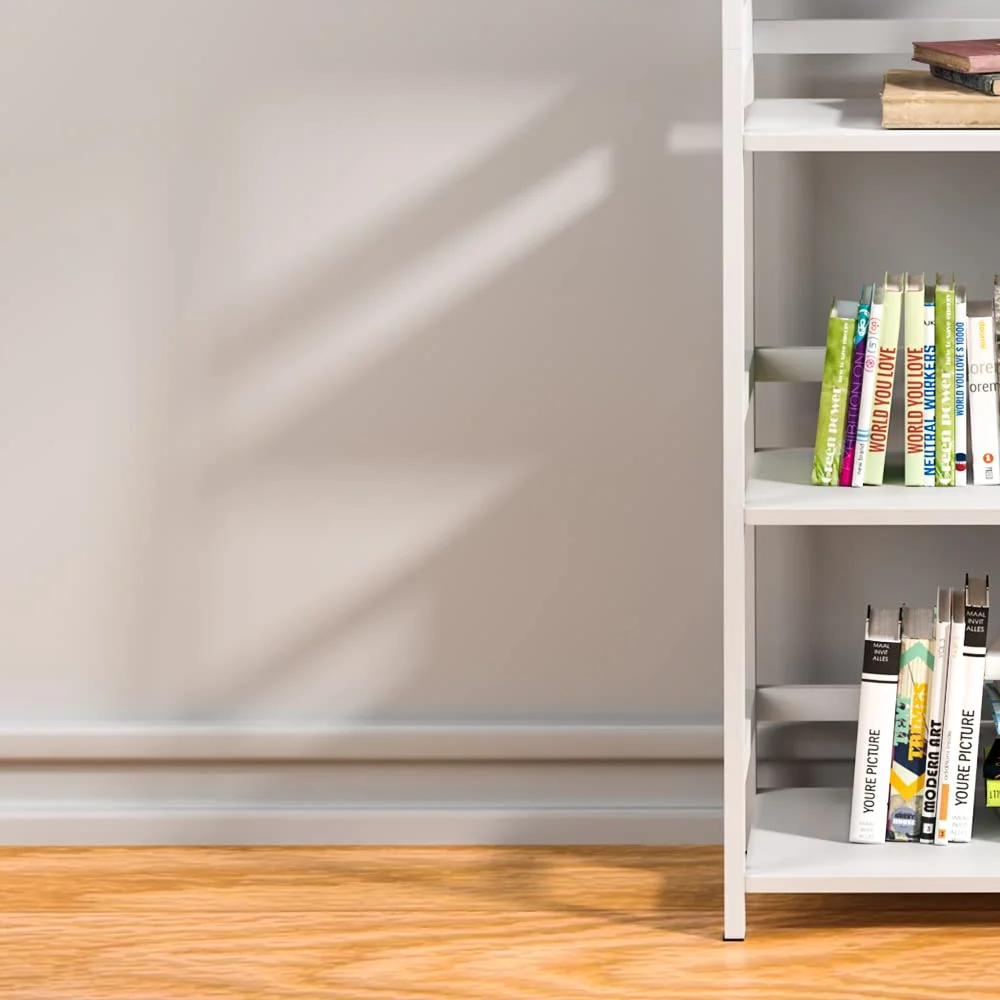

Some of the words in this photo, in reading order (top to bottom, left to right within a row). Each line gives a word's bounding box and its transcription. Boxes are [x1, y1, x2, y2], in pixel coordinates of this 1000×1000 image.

[955, 322, 965, 345] 10000
[877, 346, 896, 378] LOVE
[907, 347, 924, 378] LOVE
[924, 345, 936, 410] WORKERS
[955, 353, 964, 371] LOVE
[955, 372, 964, 389] YOU
[873, 380, 892, 407] YOU
[907, 380, 924, 407] YOU
[955, 390, 964, 416] WORLD
[869, 410, 888, 453] WORLD
[907, 411, 924, 454] WORLD
[924, 416, 936, 476] NEUTRAL
[894, 694, 911, 746] TEXT
[929, 719, 942, 747] ART
[958, 709, 975, 761] PICTURE
[866, 728, 881, 775] PICTURE
[863, 777, 877, 814] YOURE
[924, 751, 940, 813] MODERN
[954, 765, 971, 806] YOURE
